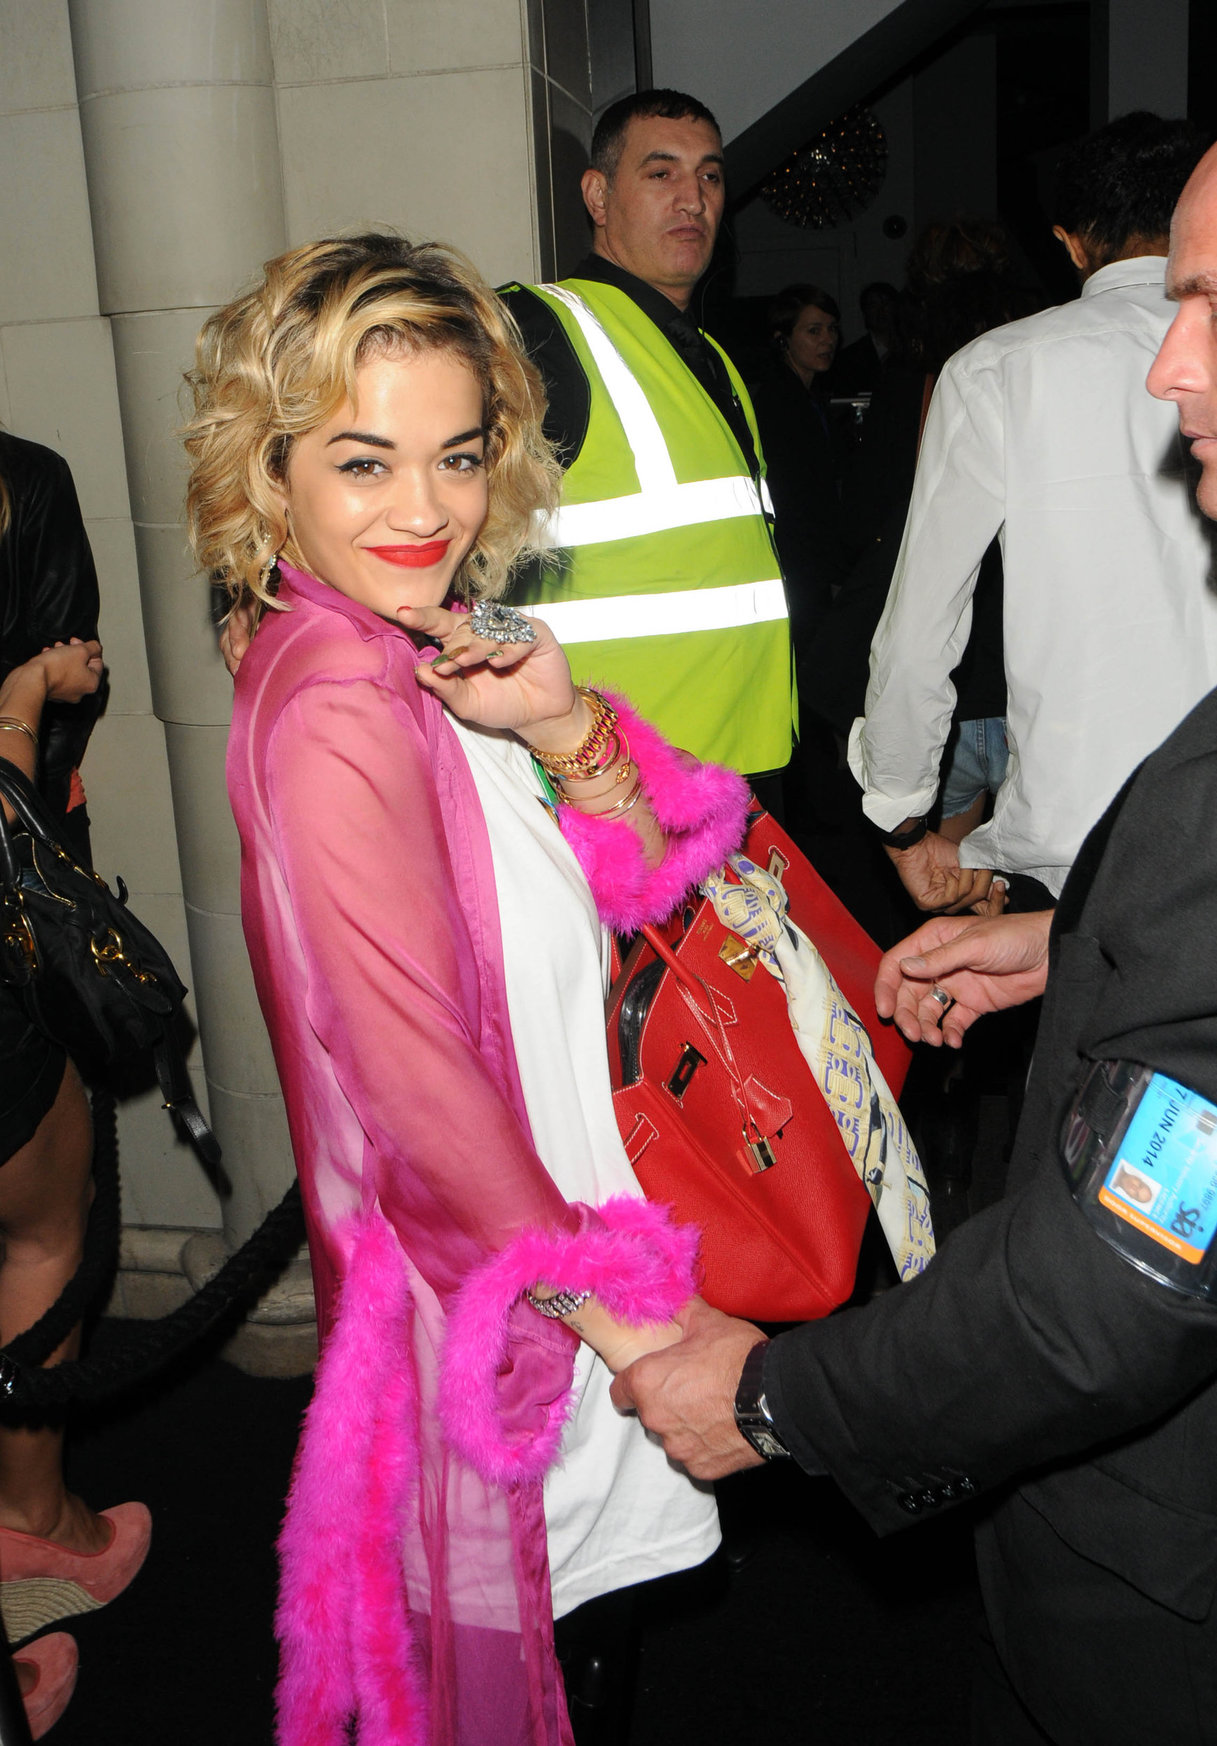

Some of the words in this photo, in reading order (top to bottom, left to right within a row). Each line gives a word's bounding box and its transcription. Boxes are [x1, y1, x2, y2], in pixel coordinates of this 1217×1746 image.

[1175, 1088, 1187, 1100] 7
[1159, 1099, 1181, 1133] JUN
[1142, 1131, 1166, 1167] 2014
[1169, 1201, 1204, 1239] sia
